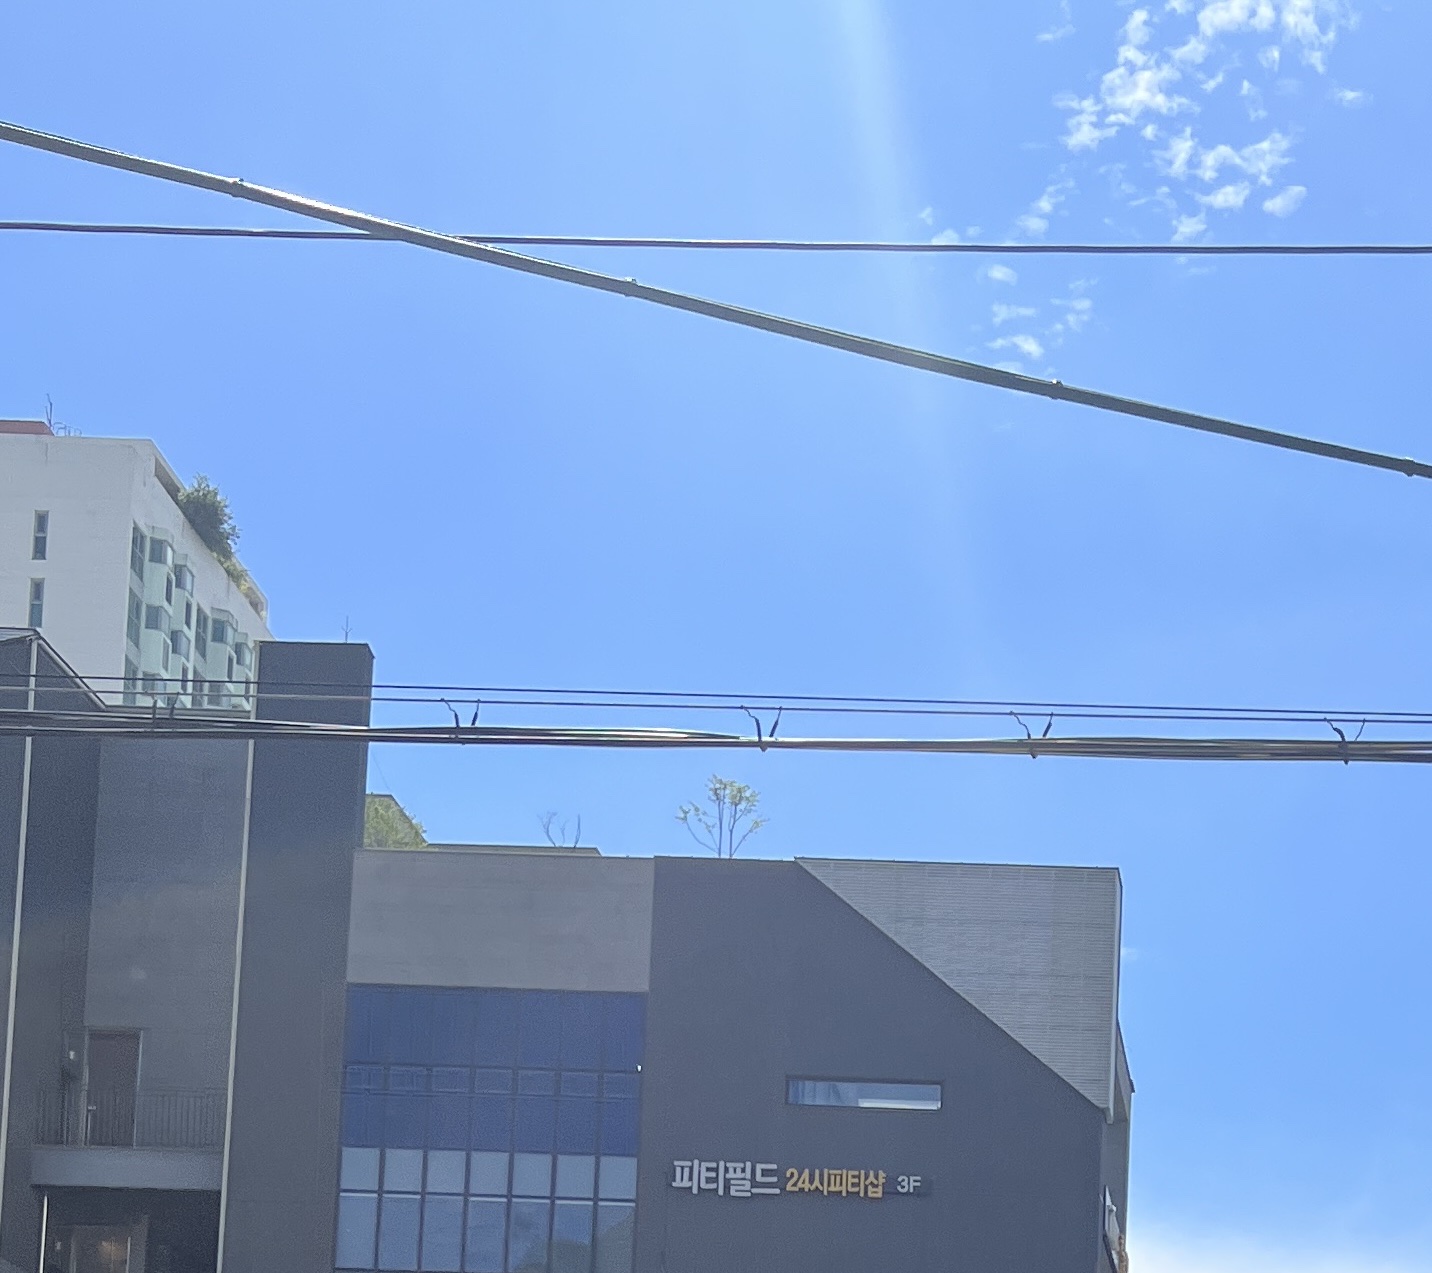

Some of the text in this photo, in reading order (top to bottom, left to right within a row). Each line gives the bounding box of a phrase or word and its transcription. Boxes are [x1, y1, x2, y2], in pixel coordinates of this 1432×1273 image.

[671, 1158, 922, 1199] 피티필드 24시피티샵 3F
